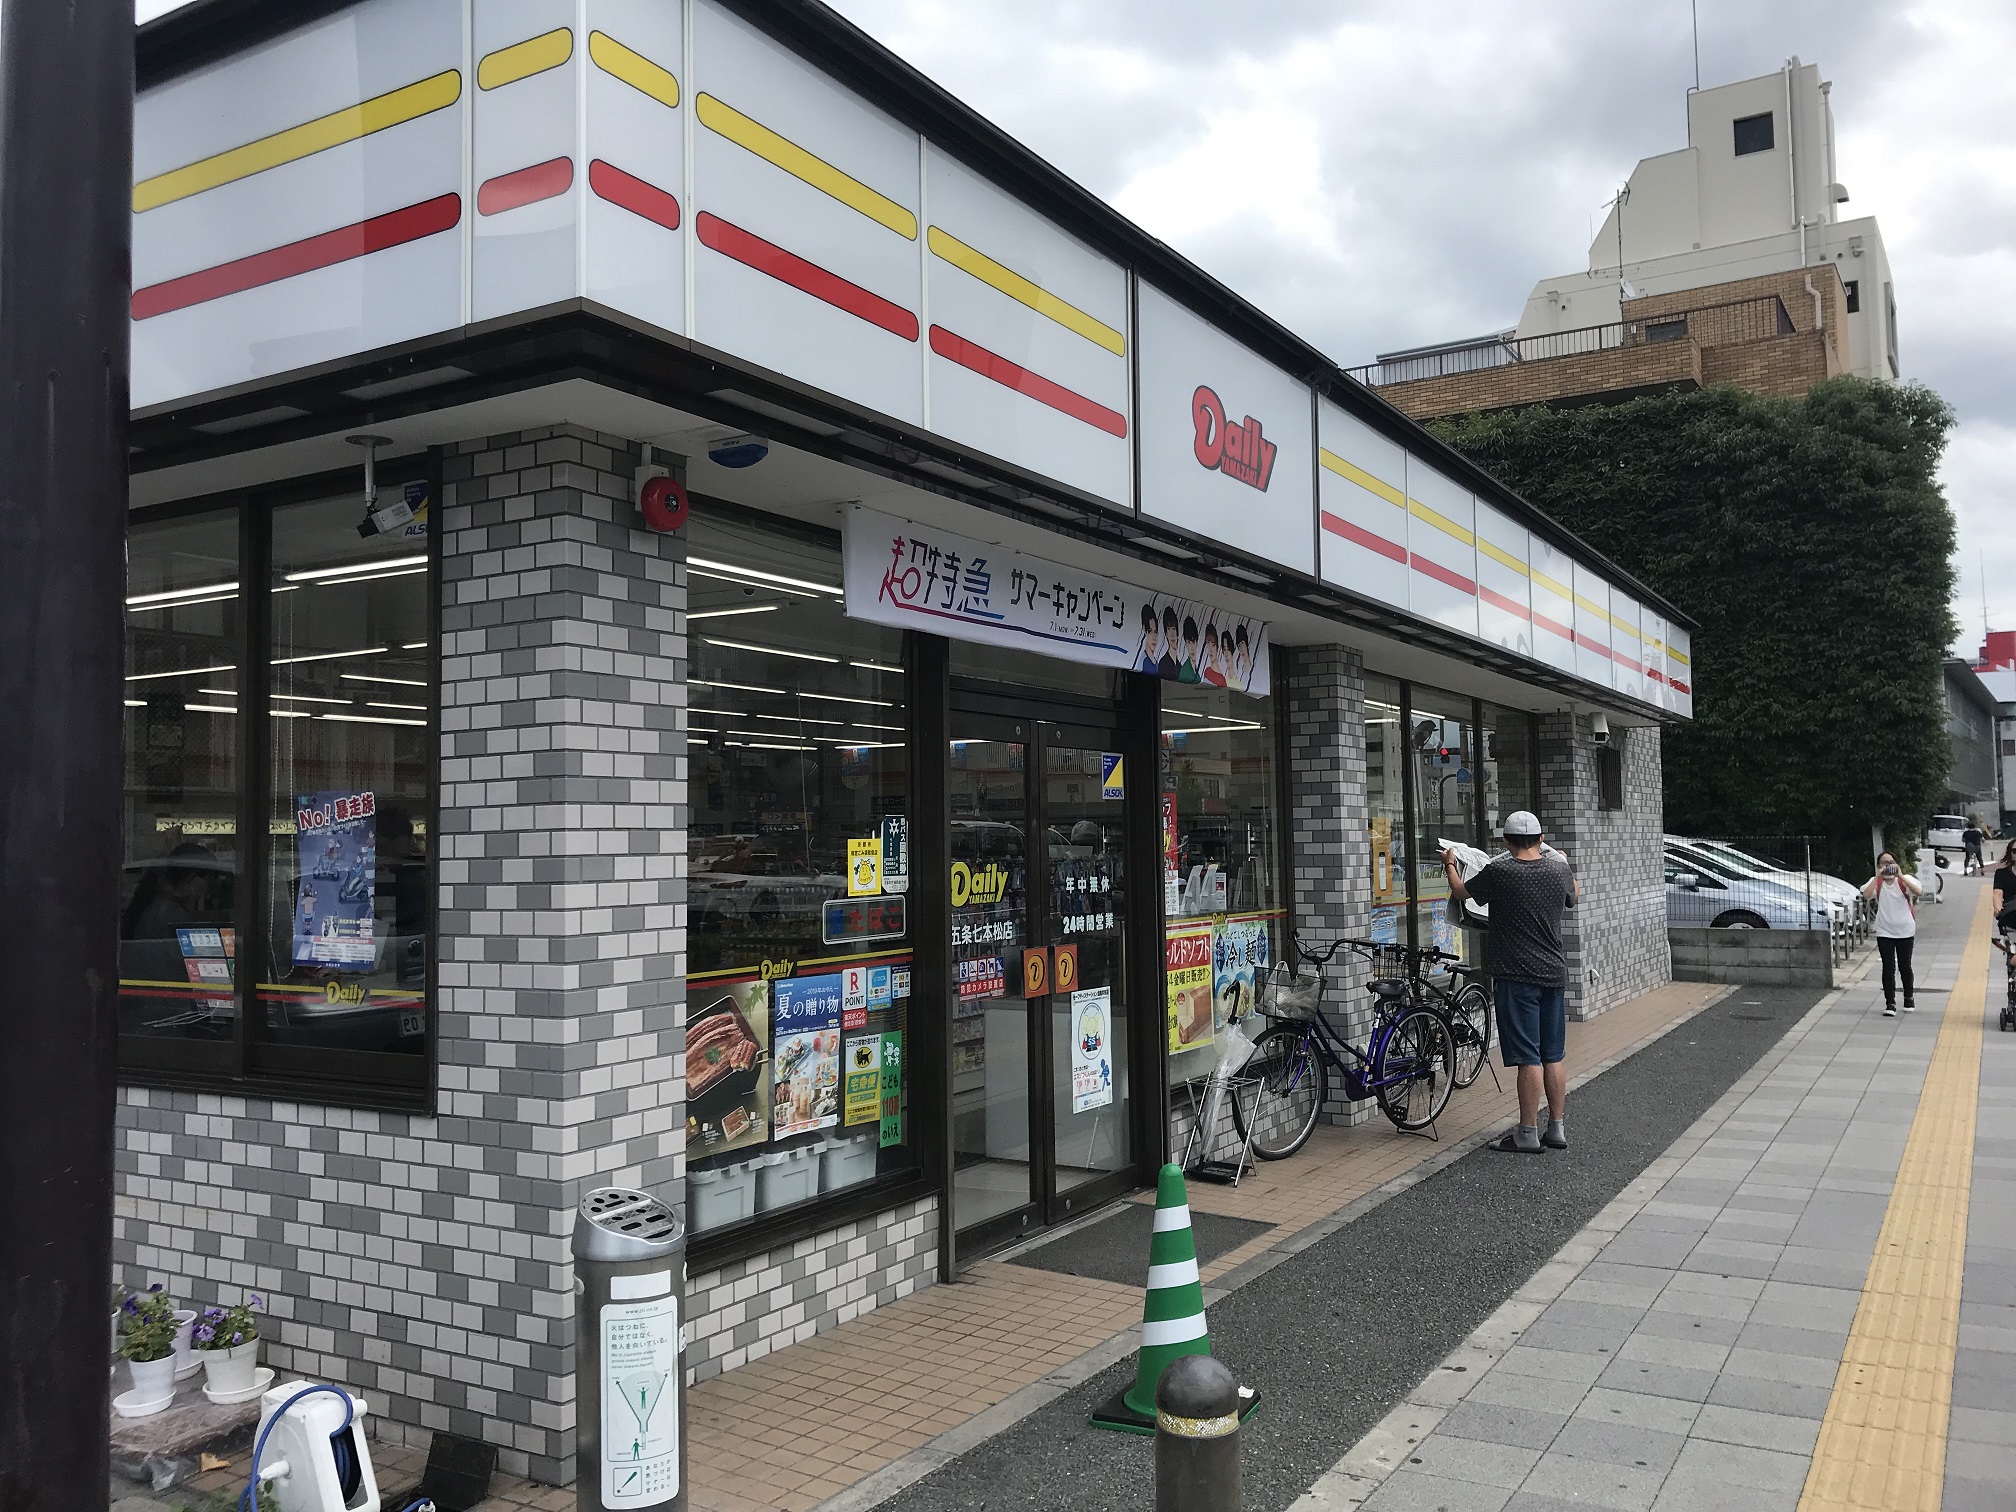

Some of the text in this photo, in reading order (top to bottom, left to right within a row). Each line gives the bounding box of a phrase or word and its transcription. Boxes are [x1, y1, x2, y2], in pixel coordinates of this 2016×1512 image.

[1192, 385, 1277, 492] Daily
[1221, 456, 1258, 487] YAMAZAKI
[405, 523, 428, 536] ALS
[1010, 568, 1125, 629] サマーキャンペーン
[1104, 788, 1123, 798] ALSOK
[298, 804, 330, 830] No!
[335, 792, 375, 822] 暴走族
[951, 861, 1009, 907] Daily
[1065, 875, 1110, 895] 年中無休
[969, 893, 996, 905] YAMAZAKI
[951, 921, 1013, 946] 五条七本松店
[1062, 912, 1114, 935] 24時間営業
[761, 959, 794, 980] Daily
[326, 981, 367, 1006] Daily
[845, 996, 864, 1006] POINT
[776, 991, 839, 1021] 夏の贈り物
[850, 1073, 877, 1092] 宅急便
[881, 1074, 899, 1090] こども
[882, 1095, 900, 1118] 110番
[882, 1123, 899, 1140] のいえ
[611, 1322, 649, 1331] 火はつねに、
[611, 1331, 653, 1341] 自分ではなく、
